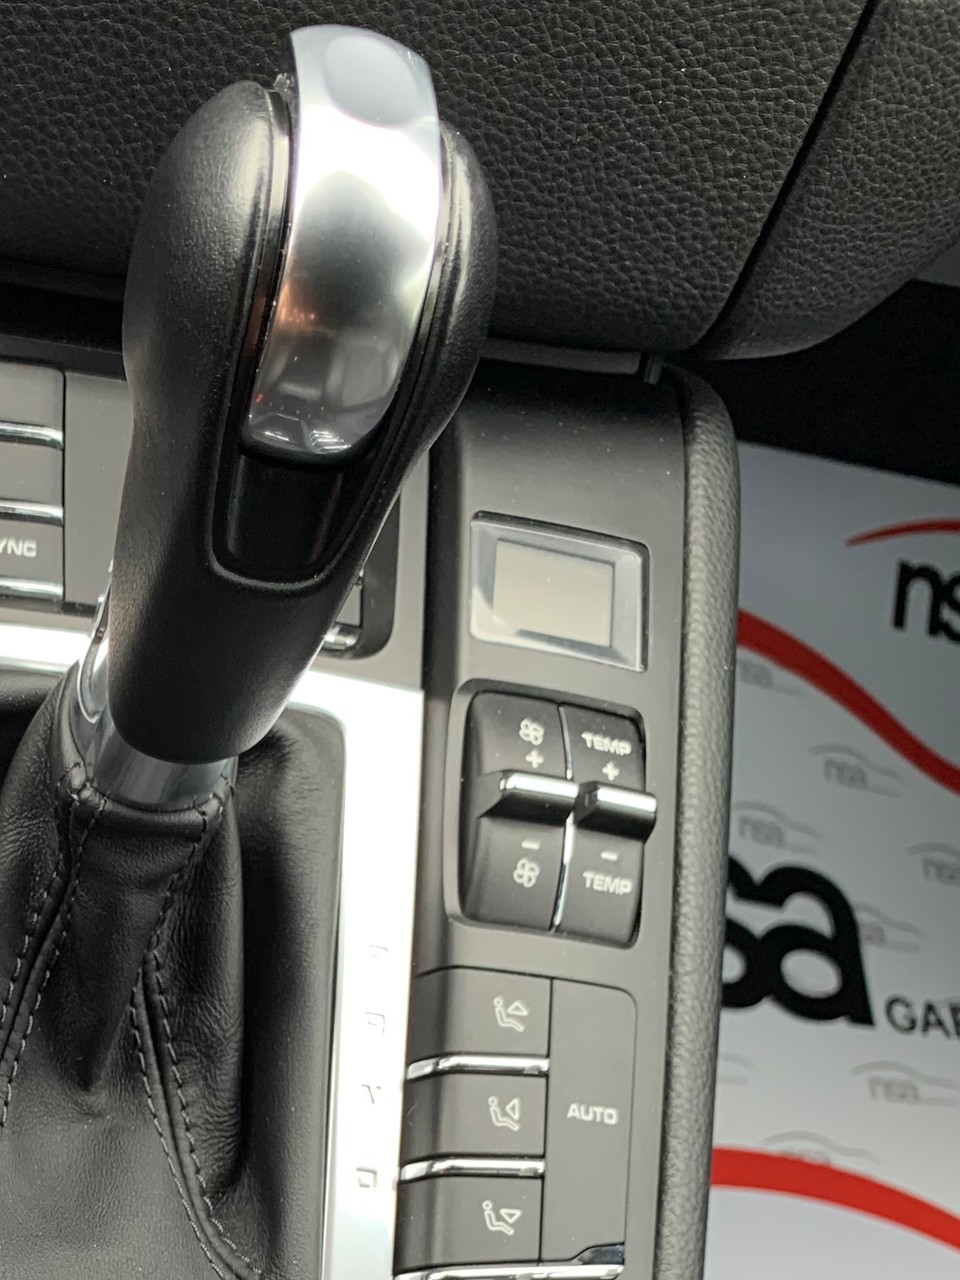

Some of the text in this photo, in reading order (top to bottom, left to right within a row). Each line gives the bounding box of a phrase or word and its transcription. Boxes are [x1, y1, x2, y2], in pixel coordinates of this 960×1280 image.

[581, 732, 632, 756] TEMP
[582, 871, 633, 895] TEMP
[566, 1103, 618, 1125] AUTO
